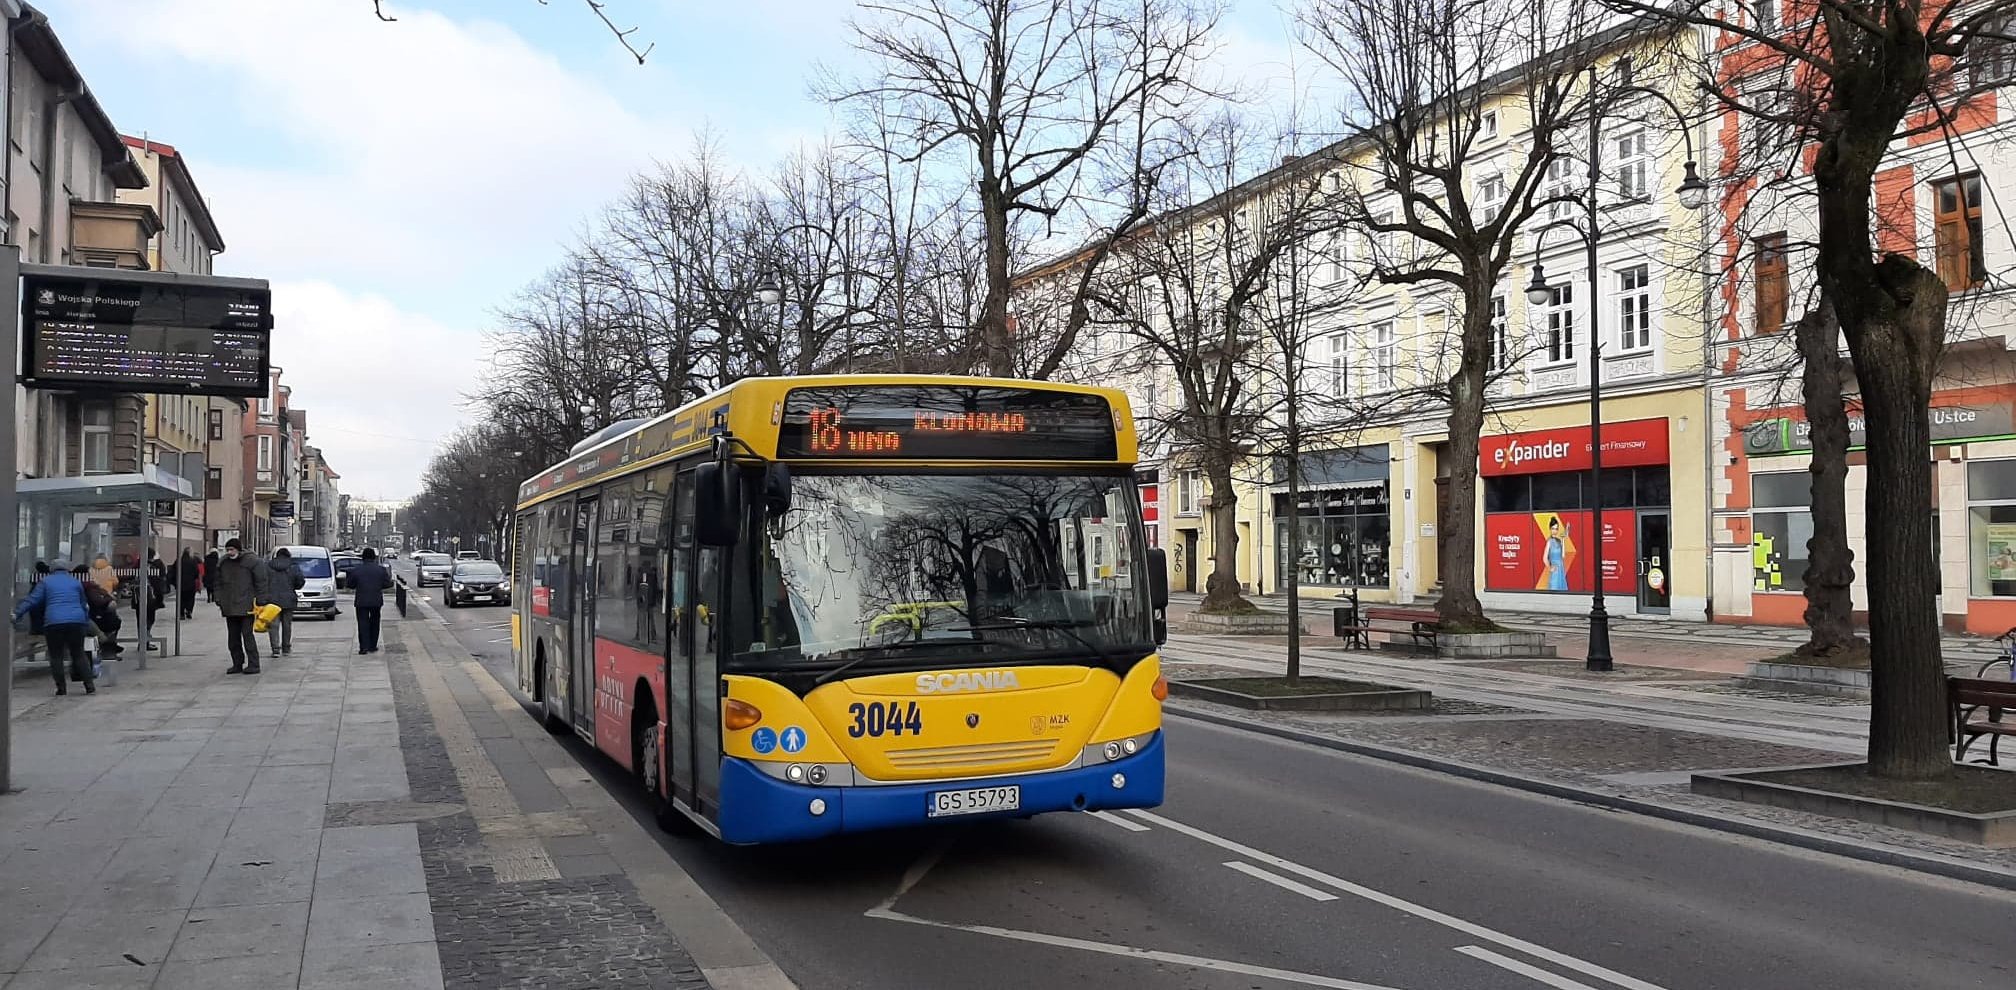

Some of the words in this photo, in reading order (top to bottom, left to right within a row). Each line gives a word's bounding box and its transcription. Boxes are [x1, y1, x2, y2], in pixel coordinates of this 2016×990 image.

[58, 294, 92, 303] Wojska
[95, 296, 140, 307] Polskiego
[811, 407, 841, 450] 18
[1934, 411, 1976, 424] Ustce
[915, 671, 1020, 695] SCANIA
[848, 702, 922, 738] 3044
[1049, 714, 1070, 724] MZK
[938, 793, 962, 811] GS
[968, 787, 1017, 808] 55793
